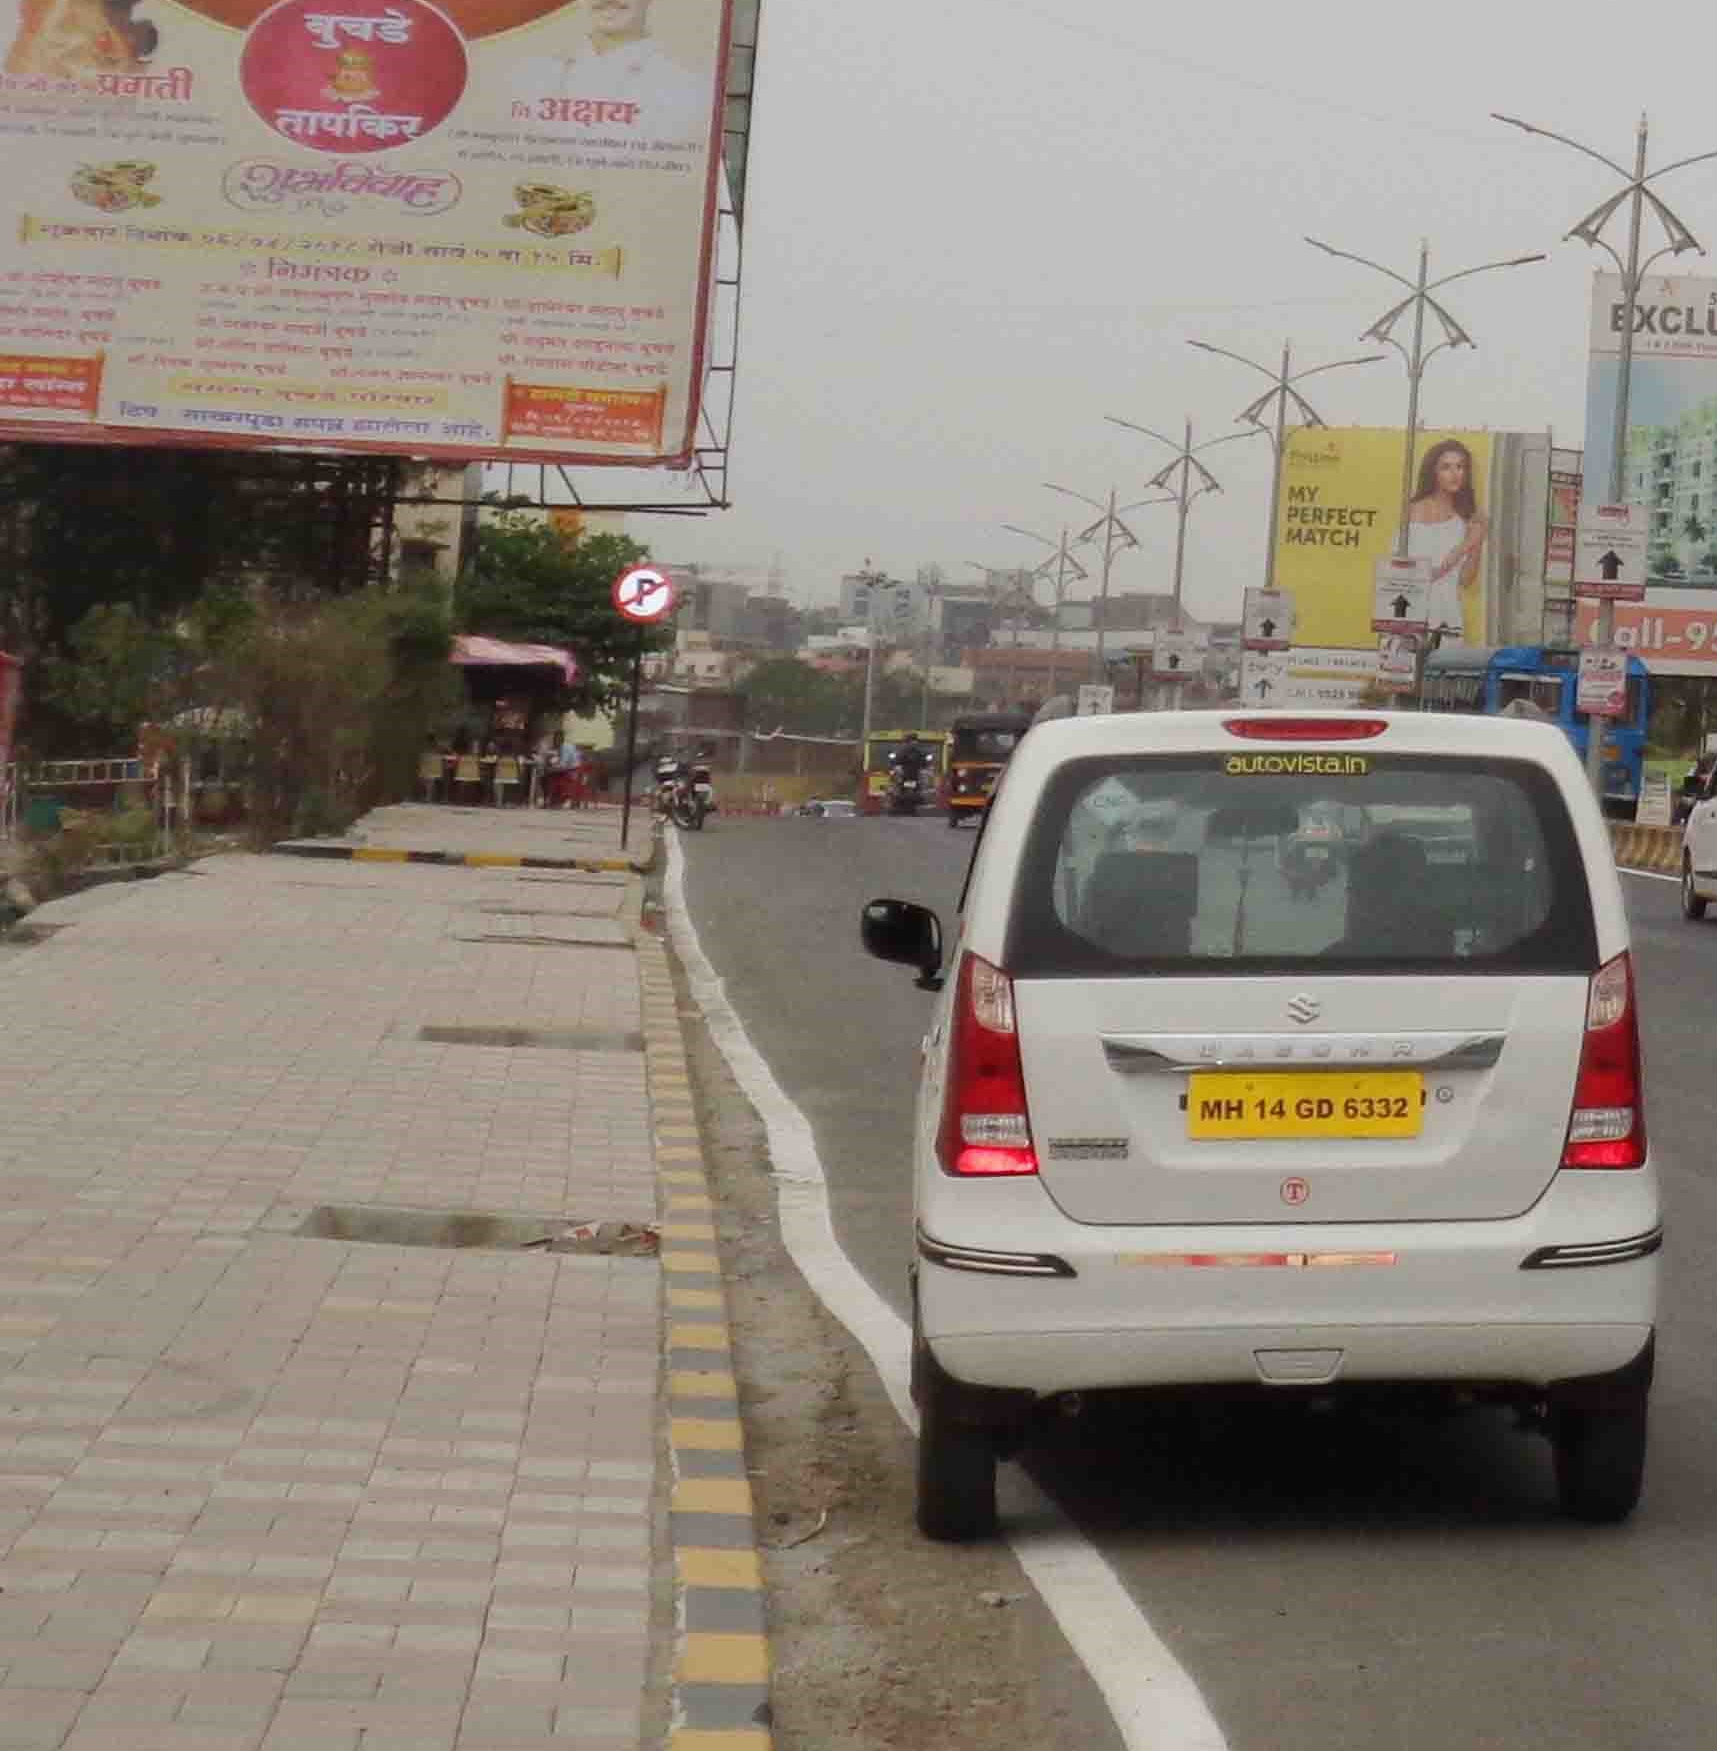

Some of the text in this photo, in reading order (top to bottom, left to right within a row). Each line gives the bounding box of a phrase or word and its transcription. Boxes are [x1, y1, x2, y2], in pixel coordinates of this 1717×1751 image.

[95, 66, 194, 101] प्रगती
[1288, 486, 1320, 502] MY
[1286, 506, 1377, 528] PERFECT
[1285, 528, 1360, 548] MATCH
[1226, 754, 1368, 775] autovista.in
[1200, 1096, 1410, 1121] MH 14 GD 6332
